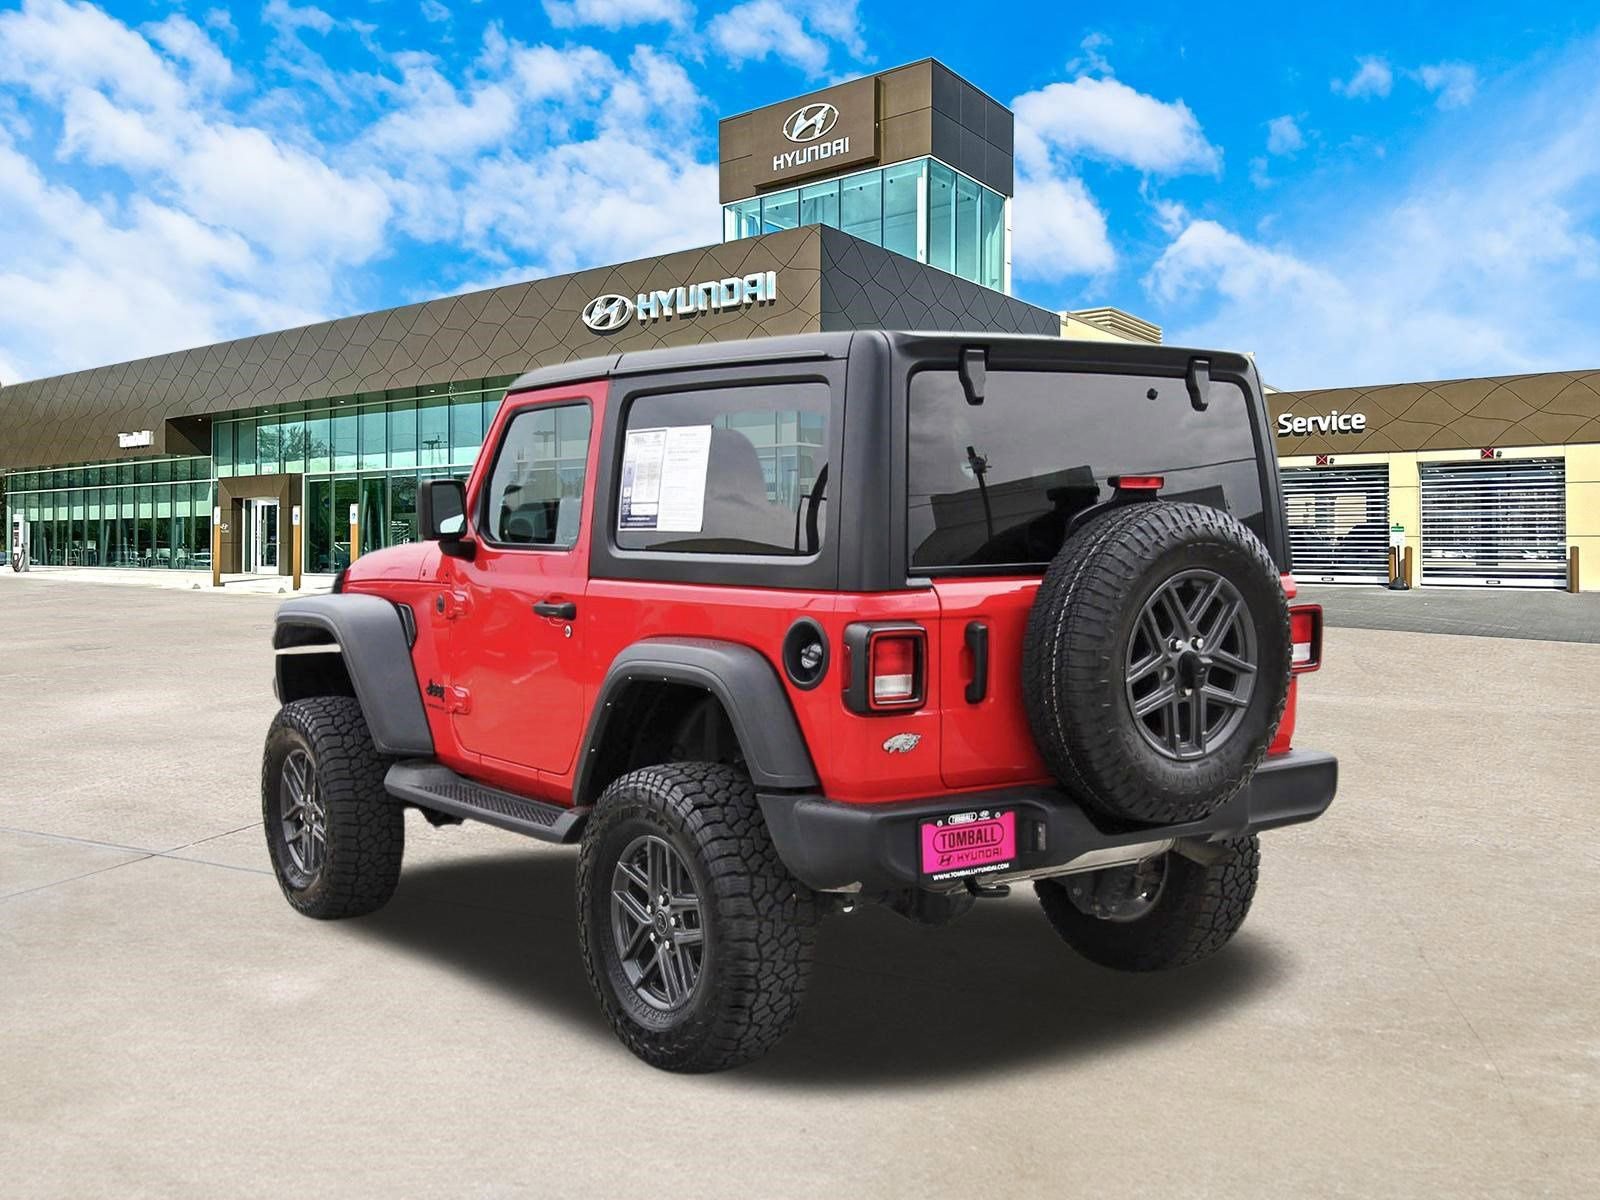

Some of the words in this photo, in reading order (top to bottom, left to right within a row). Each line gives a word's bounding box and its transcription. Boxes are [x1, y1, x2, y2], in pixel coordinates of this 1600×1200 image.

[773, 137, 850, 171] HYUNDAI
[637, 271, 776, 320] HYUNDAI
[1277, 410, 1367, 435] Service
[941, 827, 997, 849] TOMBALL
[957, 848, 1002, 861] HYUNDAI
